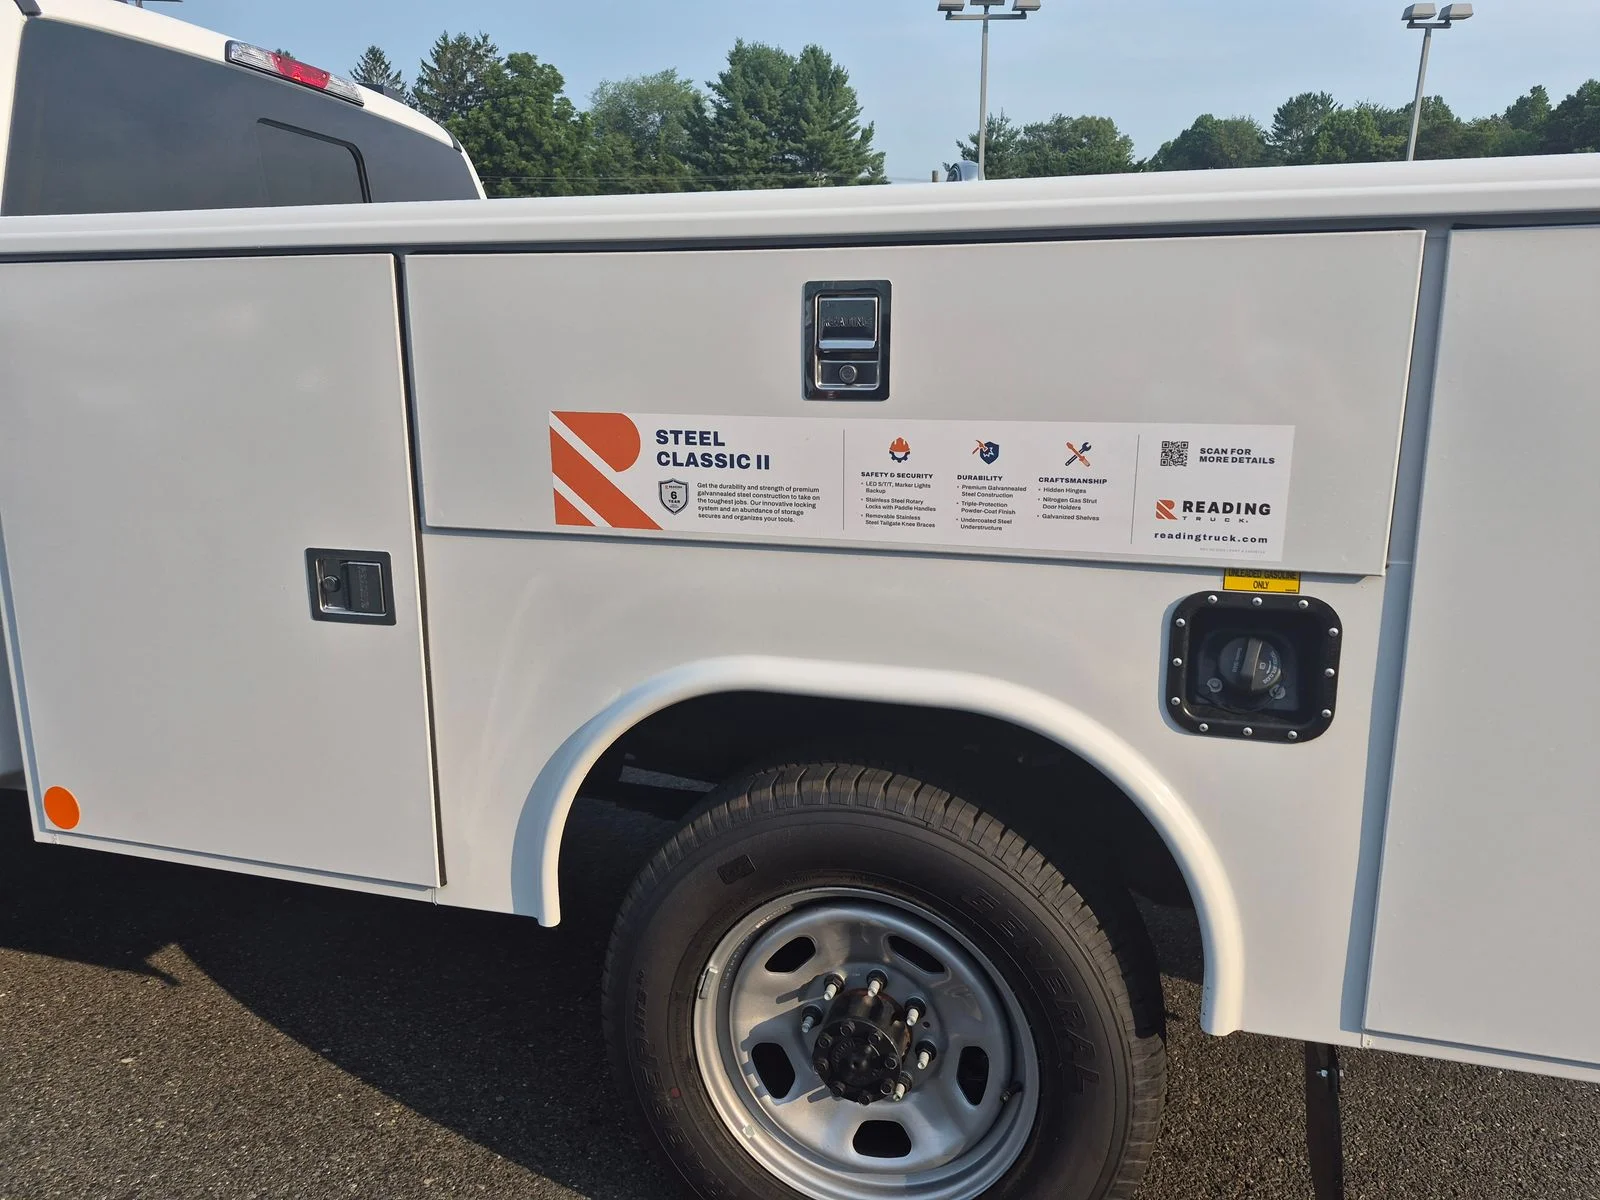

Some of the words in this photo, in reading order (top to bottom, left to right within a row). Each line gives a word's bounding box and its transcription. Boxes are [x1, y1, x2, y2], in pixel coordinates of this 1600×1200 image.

[656, 430, 725, 446] STEEL
[657, 451, 750, 469] CLASSIC
[757, 455, 769, 470] II
[670, 491, 678, 500] 6
[1182, 500, 1271, 516] READING
[1154, 532, 1268, 543] readingtruck.com
[1228, 568, 1262, 577] UNLEADED
[1263, 570, 1297, 580] GASOLINE
[1253, 581, 1270, 589] ONLY
